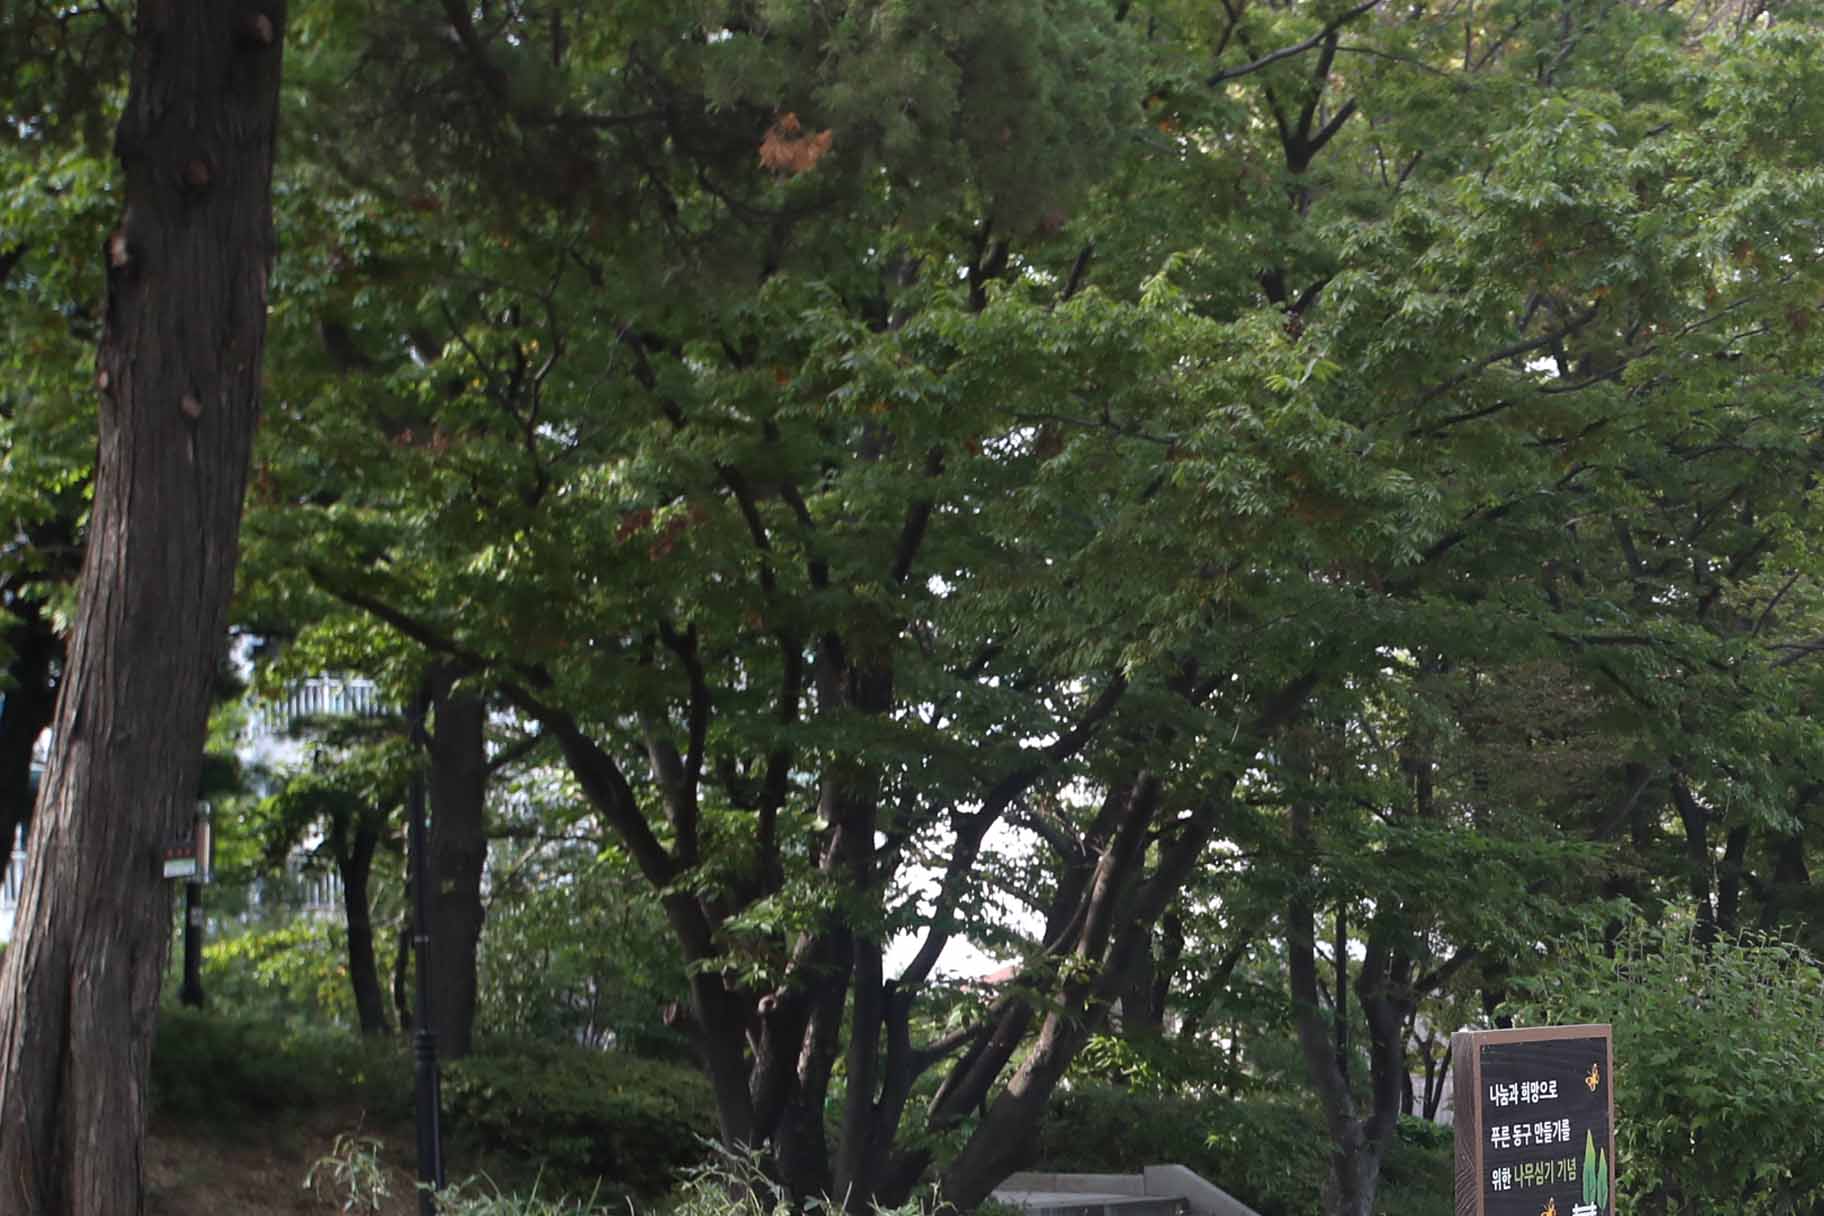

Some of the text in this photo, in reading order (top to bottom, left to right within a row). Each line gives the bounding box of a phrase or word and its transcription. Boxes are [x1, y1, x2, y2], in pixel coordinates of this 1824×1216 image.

[1490, 1080, 1558, 1107] 나눔과 희망으로
[1491, 1119, 1571, 1149] 푸른 동구 만들기를
[1492, 1157, 1577, 1191] 위한 나무심기 기념
